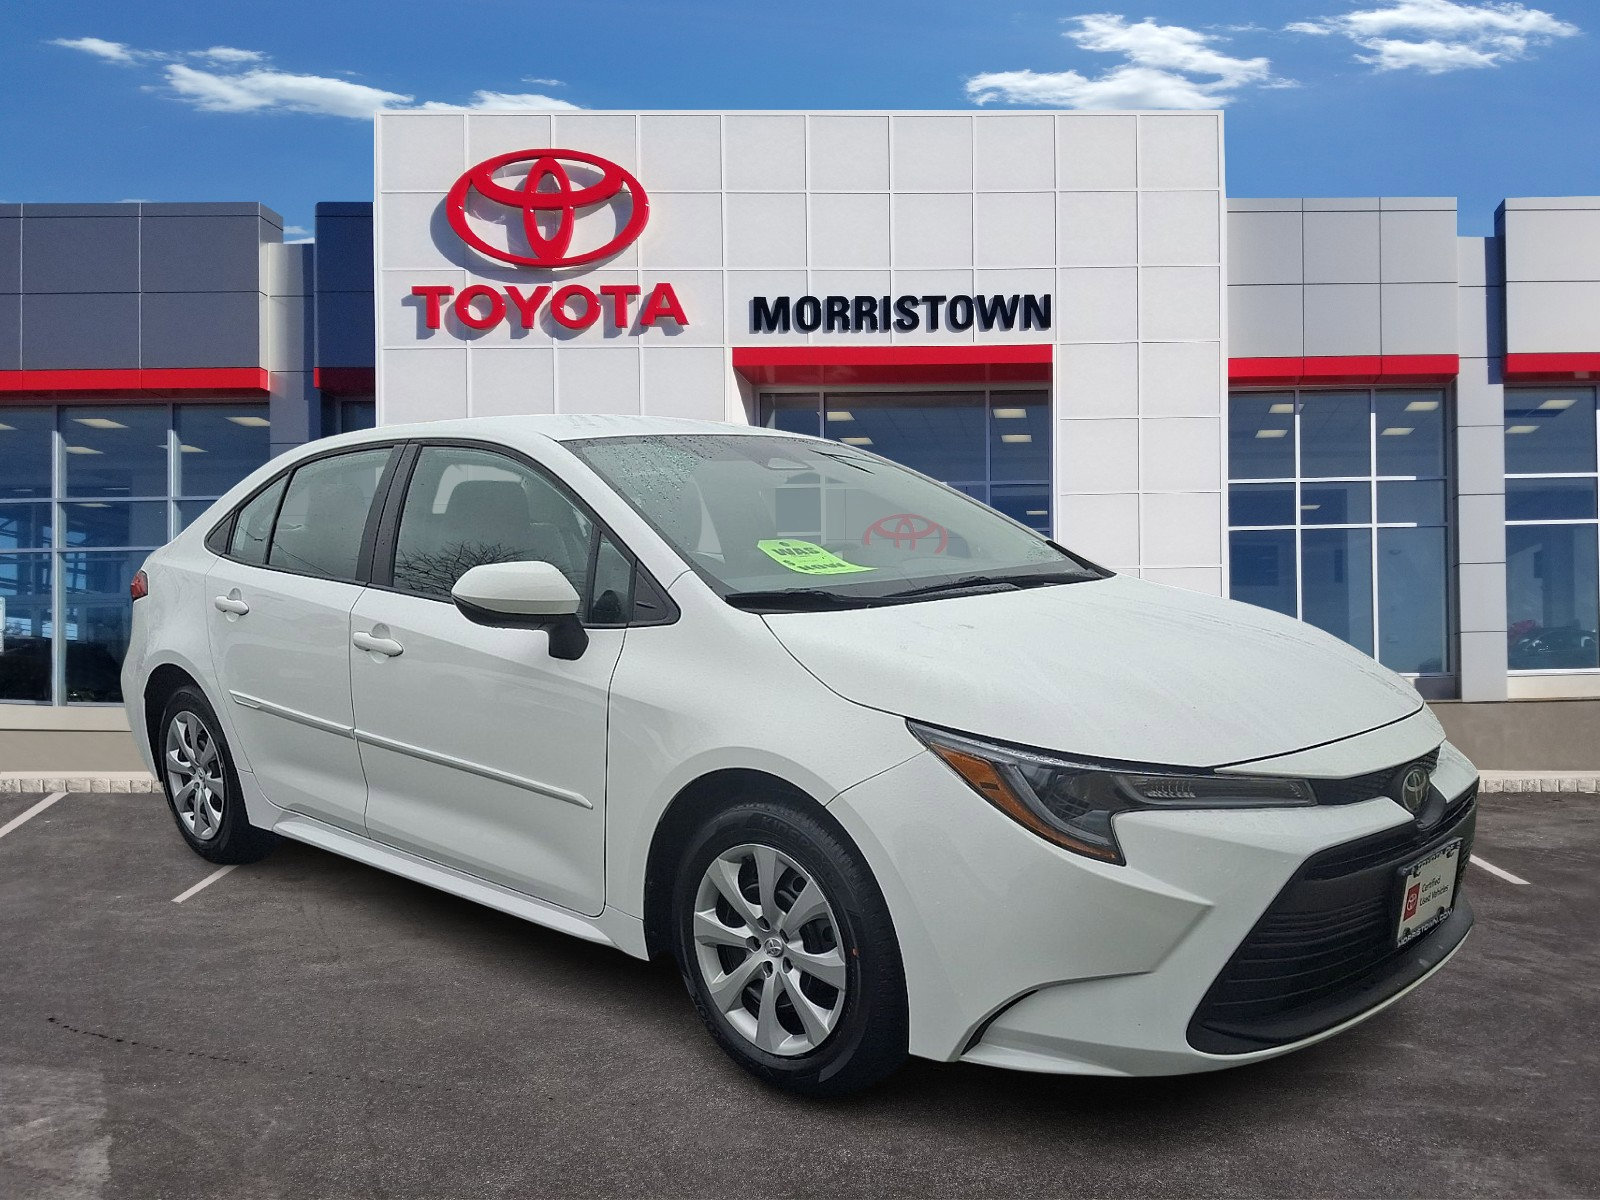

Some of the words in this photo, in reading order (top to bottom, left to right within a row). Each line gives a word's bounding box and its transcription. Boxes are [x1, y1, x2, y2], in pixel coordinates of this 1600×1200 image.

[411, 283, 690, 330] TOYOTA
[753, 294, 1051, 331] MORRISTOWN
[772, 547, 820, 556] WAS
[1421, 874, 1441, 893] Certified
